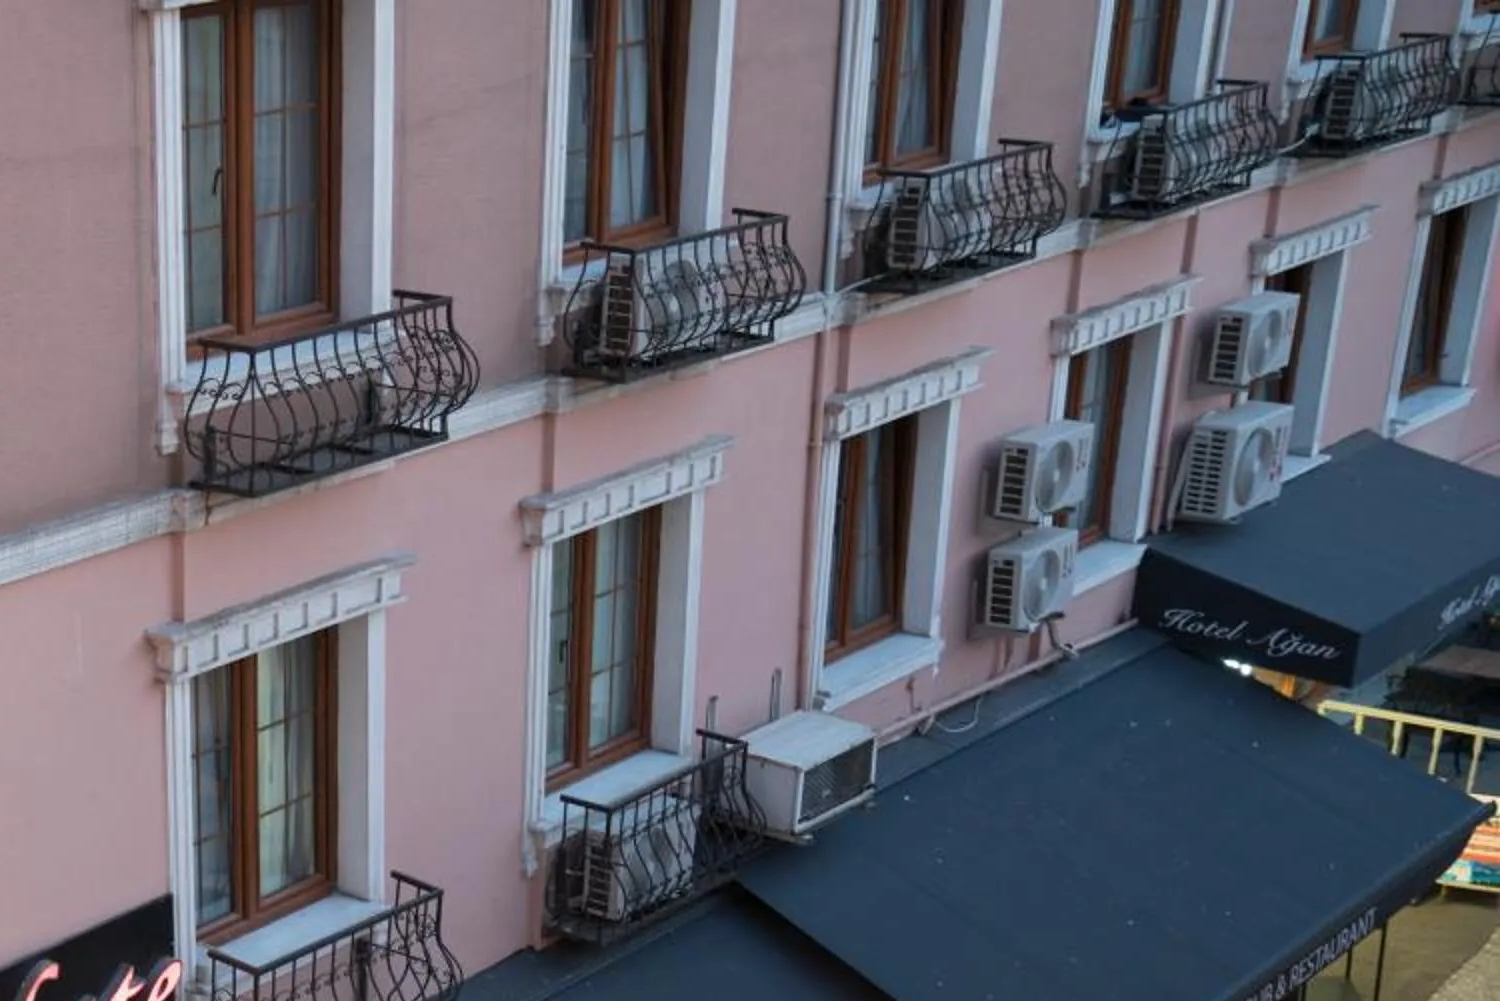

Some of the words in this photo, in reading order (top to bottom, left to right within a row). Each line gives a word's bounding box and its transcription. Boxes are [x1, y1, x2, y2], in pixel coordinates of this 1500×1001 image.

[1158, 607, 1250, 642] Hotel
[1247, 627, 1342, 659] Ağan
[1275, 972, 1289, 1001] &
[1288, 906, 1380, 991] RESTAURANT
